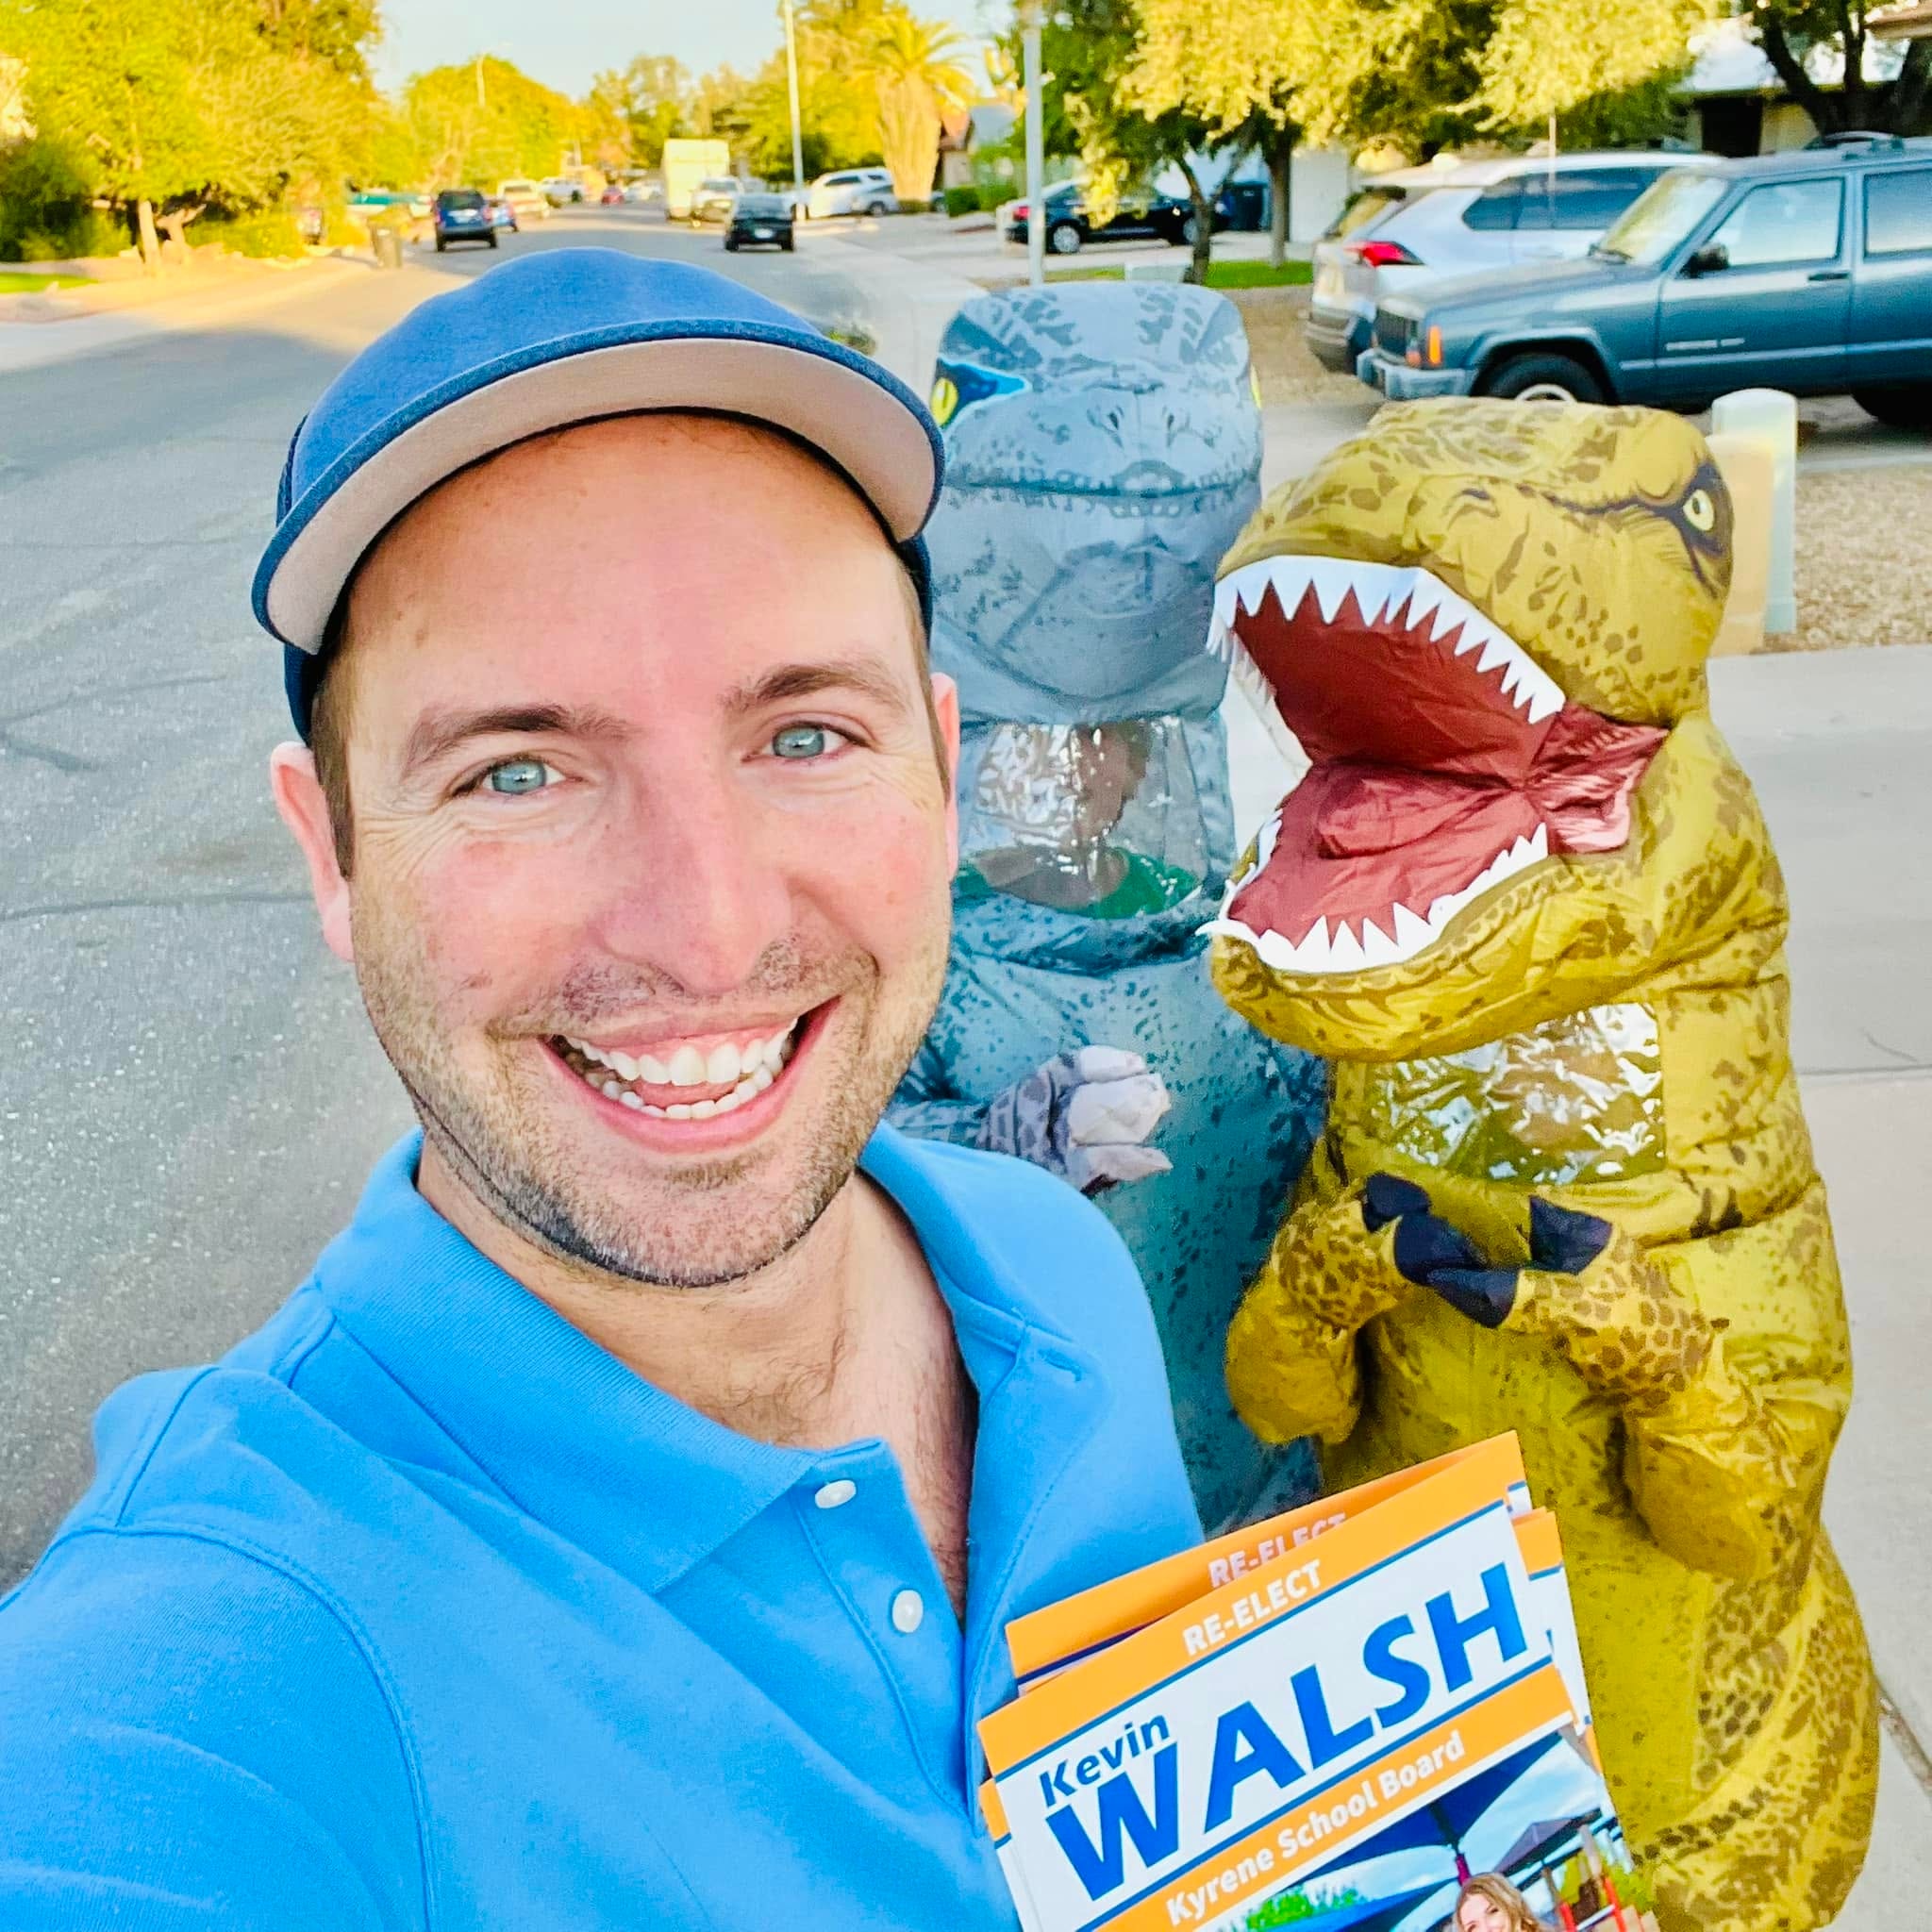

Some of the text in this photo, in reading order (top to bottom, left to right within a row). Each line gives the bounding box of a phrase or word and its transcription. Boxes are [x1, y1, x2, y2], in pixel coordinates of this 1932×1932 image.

[1182, 1560, 1322, 1655] RE-ELECT
[1039, 1714, 1170, 1808] Kevin
[1045, 1563, 1527, 1901] WALSH
[1167, 1729, 1466, 1926] Kyrene School Board
